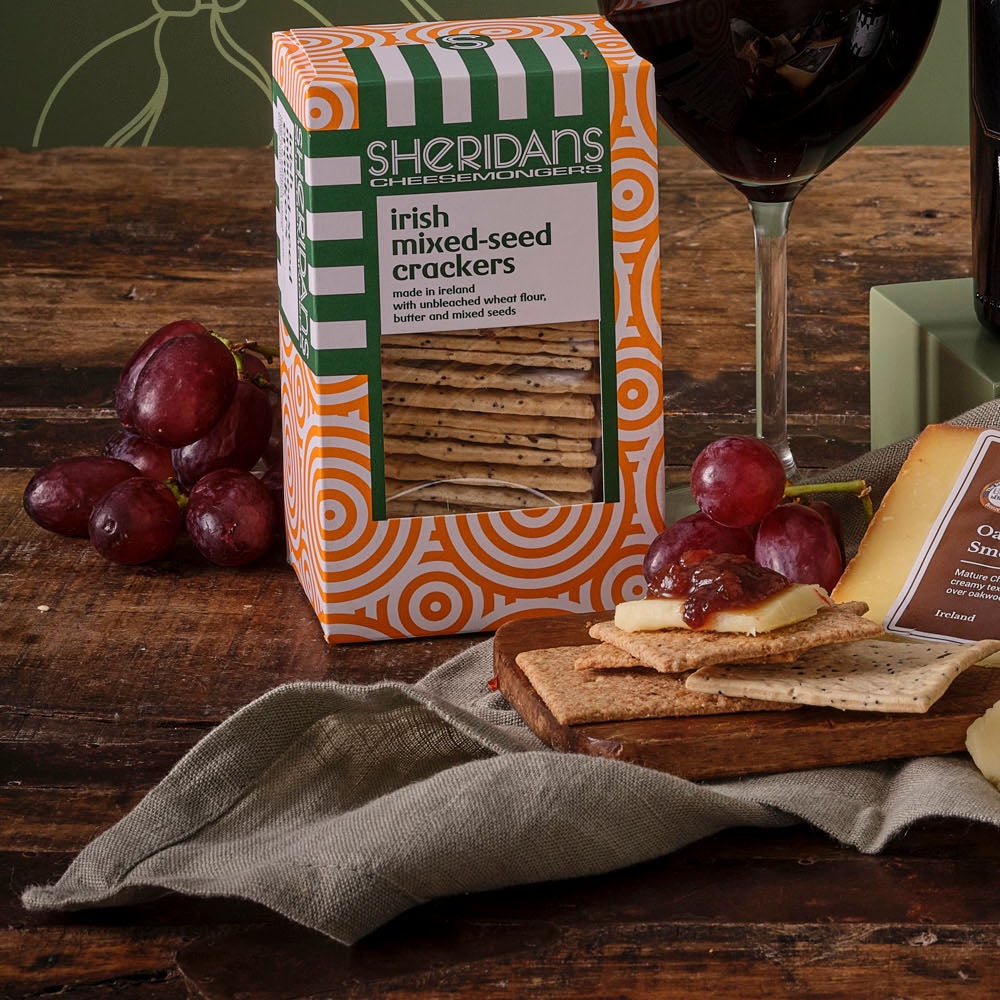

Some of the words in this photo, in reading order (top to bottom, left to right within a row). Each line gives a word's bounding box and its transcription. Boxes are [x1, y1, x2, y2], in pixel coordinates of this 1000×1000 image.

[369, 164, 603, 188] CHEESEMONGERS
[391, 204, 449, 231] irish
[392, 222, 552, 256] mixed-seed
[392, 253, 516, 281] crackers
[393, 288, 422, 298] made
[425, 287, 435, 296] in
[438, 284, 475, 295] ireland
[393, 300, 416, 310] with
[420, 296, 481, 309] unbleached
[484, 294, 517, 305] wheat
[520, 292, 547, 302] flour,
[393, 313, 426, 323] butter
[429, 310, 449, 321] and
[452, 308, 484, 320] mixed
[487, 306, 517, 317] seeds
[954, 568, 988, 581] Mature
[946, 588, 967, 596] over
[950, 579, 985, 591] creamy
[934, 609, 977, 622] Ireland
